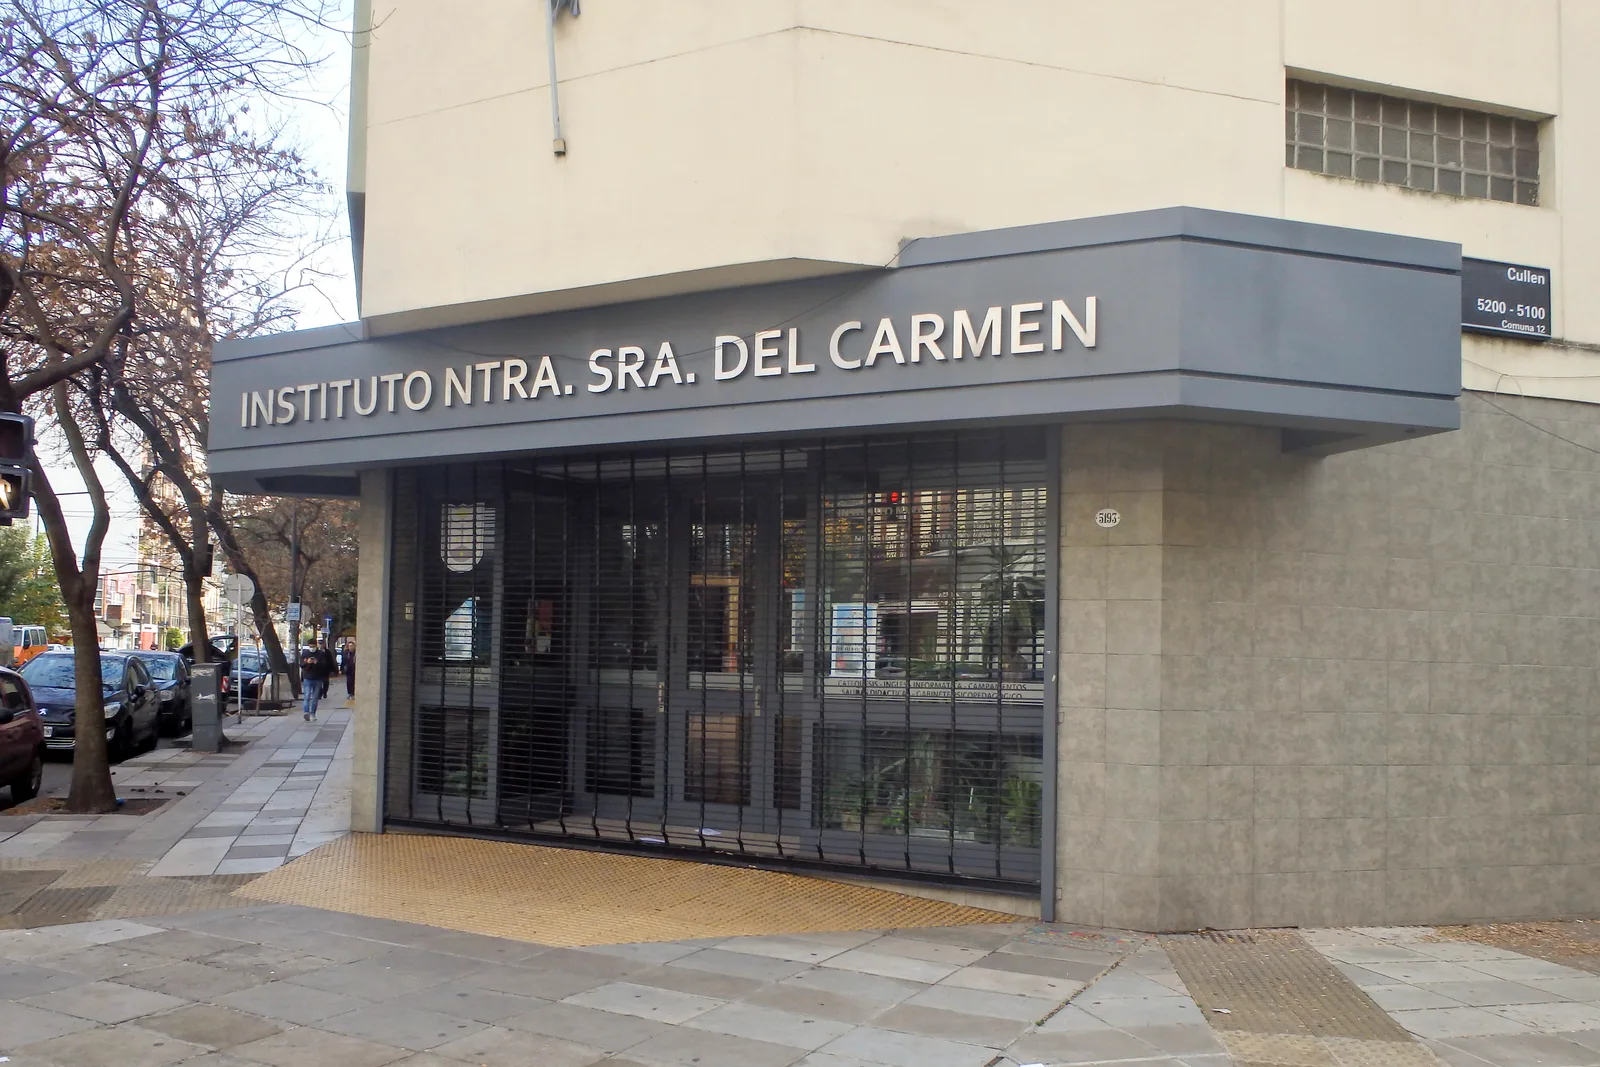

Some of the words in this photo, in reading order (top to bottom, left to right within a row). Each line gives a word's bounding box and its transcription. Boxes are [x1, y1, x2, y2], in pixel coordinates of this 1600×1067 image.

[1507, 267, 1545, 285] Cullen
[1477, 298, 1506, 314] 5200
[1516, 304, 1545, 320] 5100
[1501, 320, 1534, 332] Comuna
[1536, 325, 1546, 334] 12
[241, 370, 432, 427] INSTITUTO
[445, 356, 574, 407] NTRA.
[587, 341, 696, 393] SRA.
[714, 327, 816, 381] DEL
[829, 296, 1097, 370] CARMEN
[838, 679, 878, 688] CATEQESIS
[913, 681, 962, 690] INFORMATA
